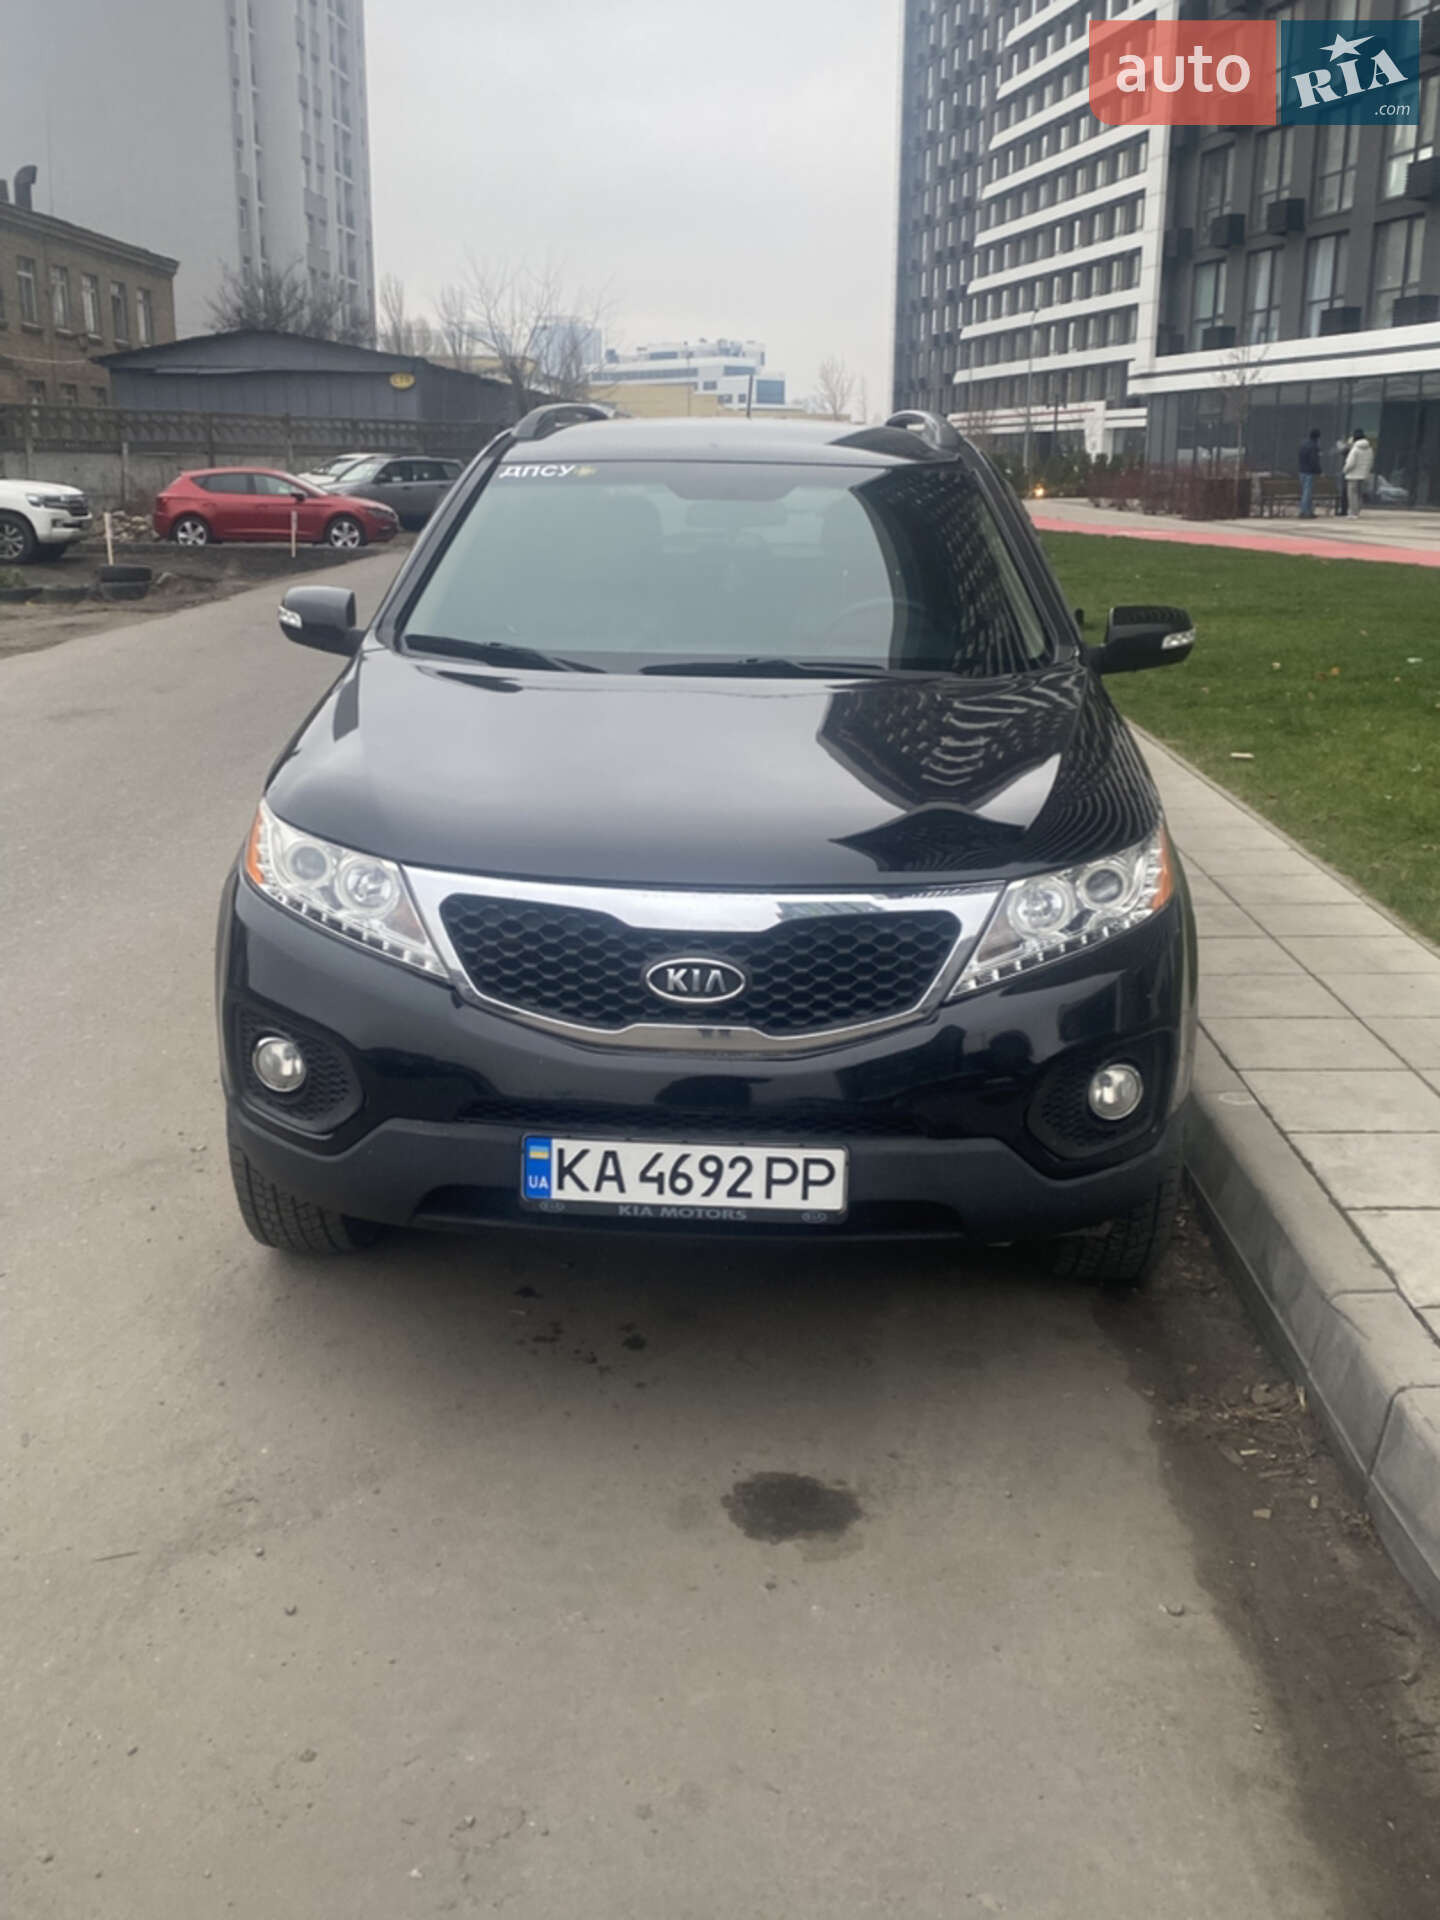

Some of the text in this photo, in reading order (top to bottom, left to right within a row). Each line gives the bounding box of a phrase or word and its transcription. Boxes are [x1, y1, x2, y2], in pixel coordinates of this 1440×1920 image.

[499, 464, 577, 479] ДПСУ
[666, 967, 727, 993] KIA
[528, 1175, 549, 1190] UA
[556, 1147, 836, 1201] KA 4692 PP
[618, 1204, 747, 1221] KIA MOTORS
